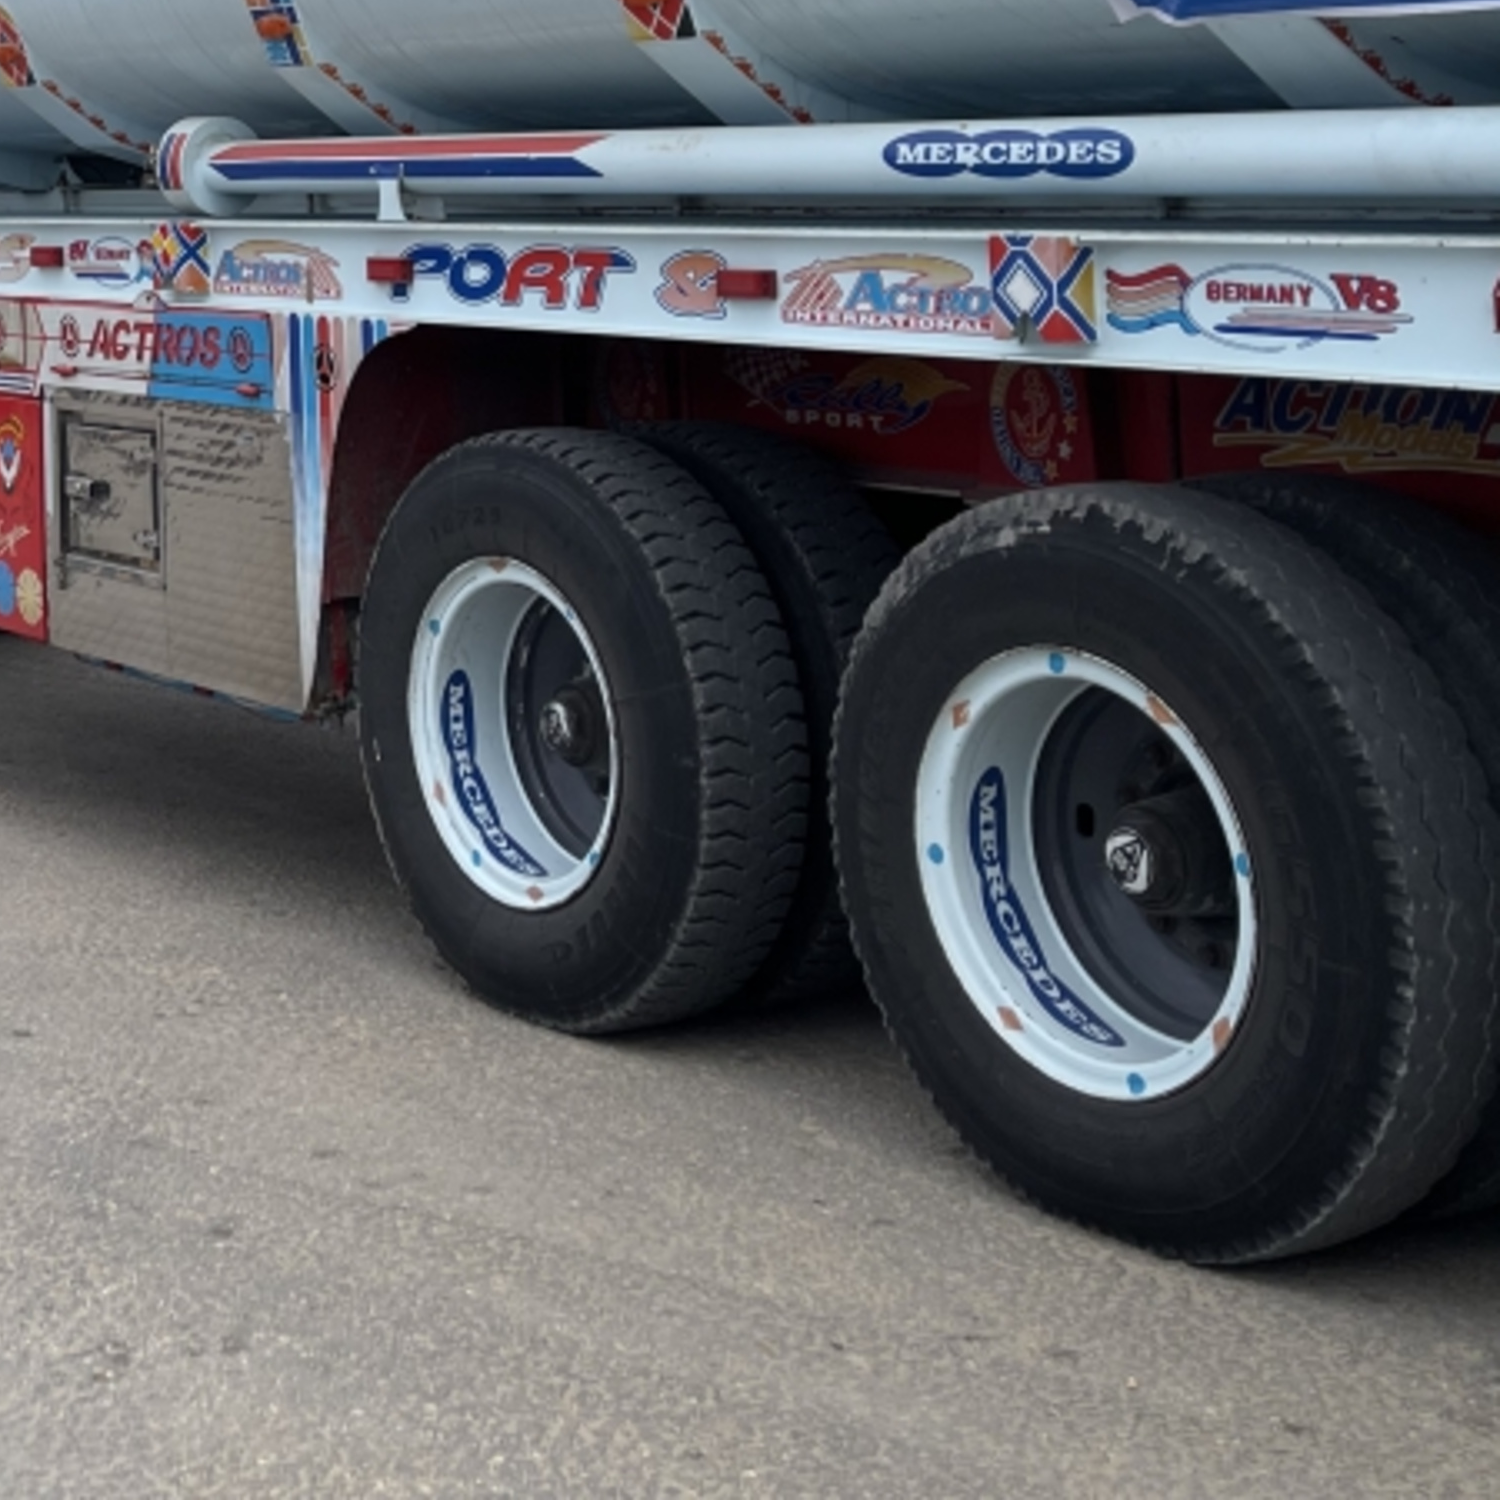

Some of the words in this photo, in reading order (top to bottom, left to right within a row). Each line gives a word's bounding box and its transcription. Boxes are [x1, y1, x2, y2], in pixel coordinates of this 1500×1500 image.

[895, 140, 1122, 165] MERCEDES
[388, 242, 638, 312] PORT
[1330, 273, 1401, 314] V8
[88, 318, 221, 370] ACTROS
[784, 308, 994, 334] INTERNATIONAL
[784, 408, 885, 433] SPORT
[448, 682, 544, 877] MERCEDES
[978, 781, 1116, 1044] MERCEDES
